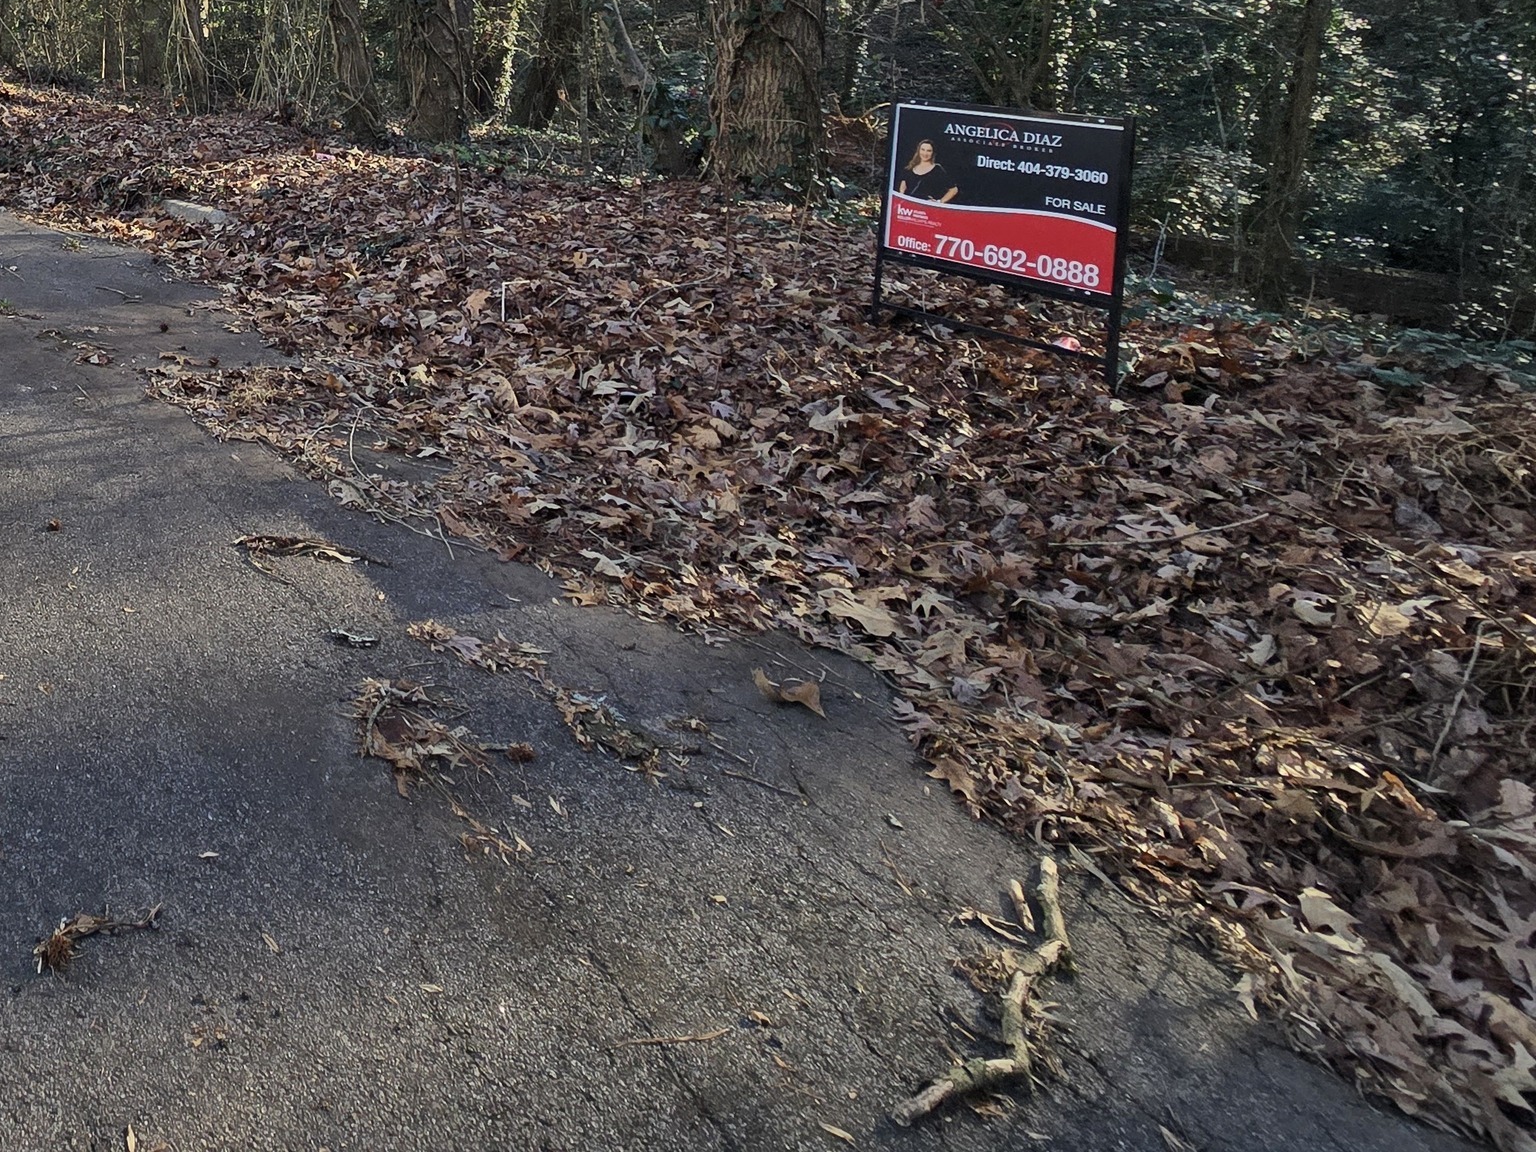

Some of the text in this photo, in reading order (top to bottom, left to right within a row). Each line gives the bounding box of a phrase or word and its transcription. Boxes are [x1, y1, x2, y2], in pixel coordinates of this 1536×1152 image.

[944, 123, 1063, 148] ANGELICA DIAZ
[1013, 144, 1054, 154] BROKER
[977, 155, 1109, 185] Direct: 404-379-3060
[1045, 196, 1106, 215] FOR SALE
[897, 233, 1100, 287] Office: 770-692-0888
